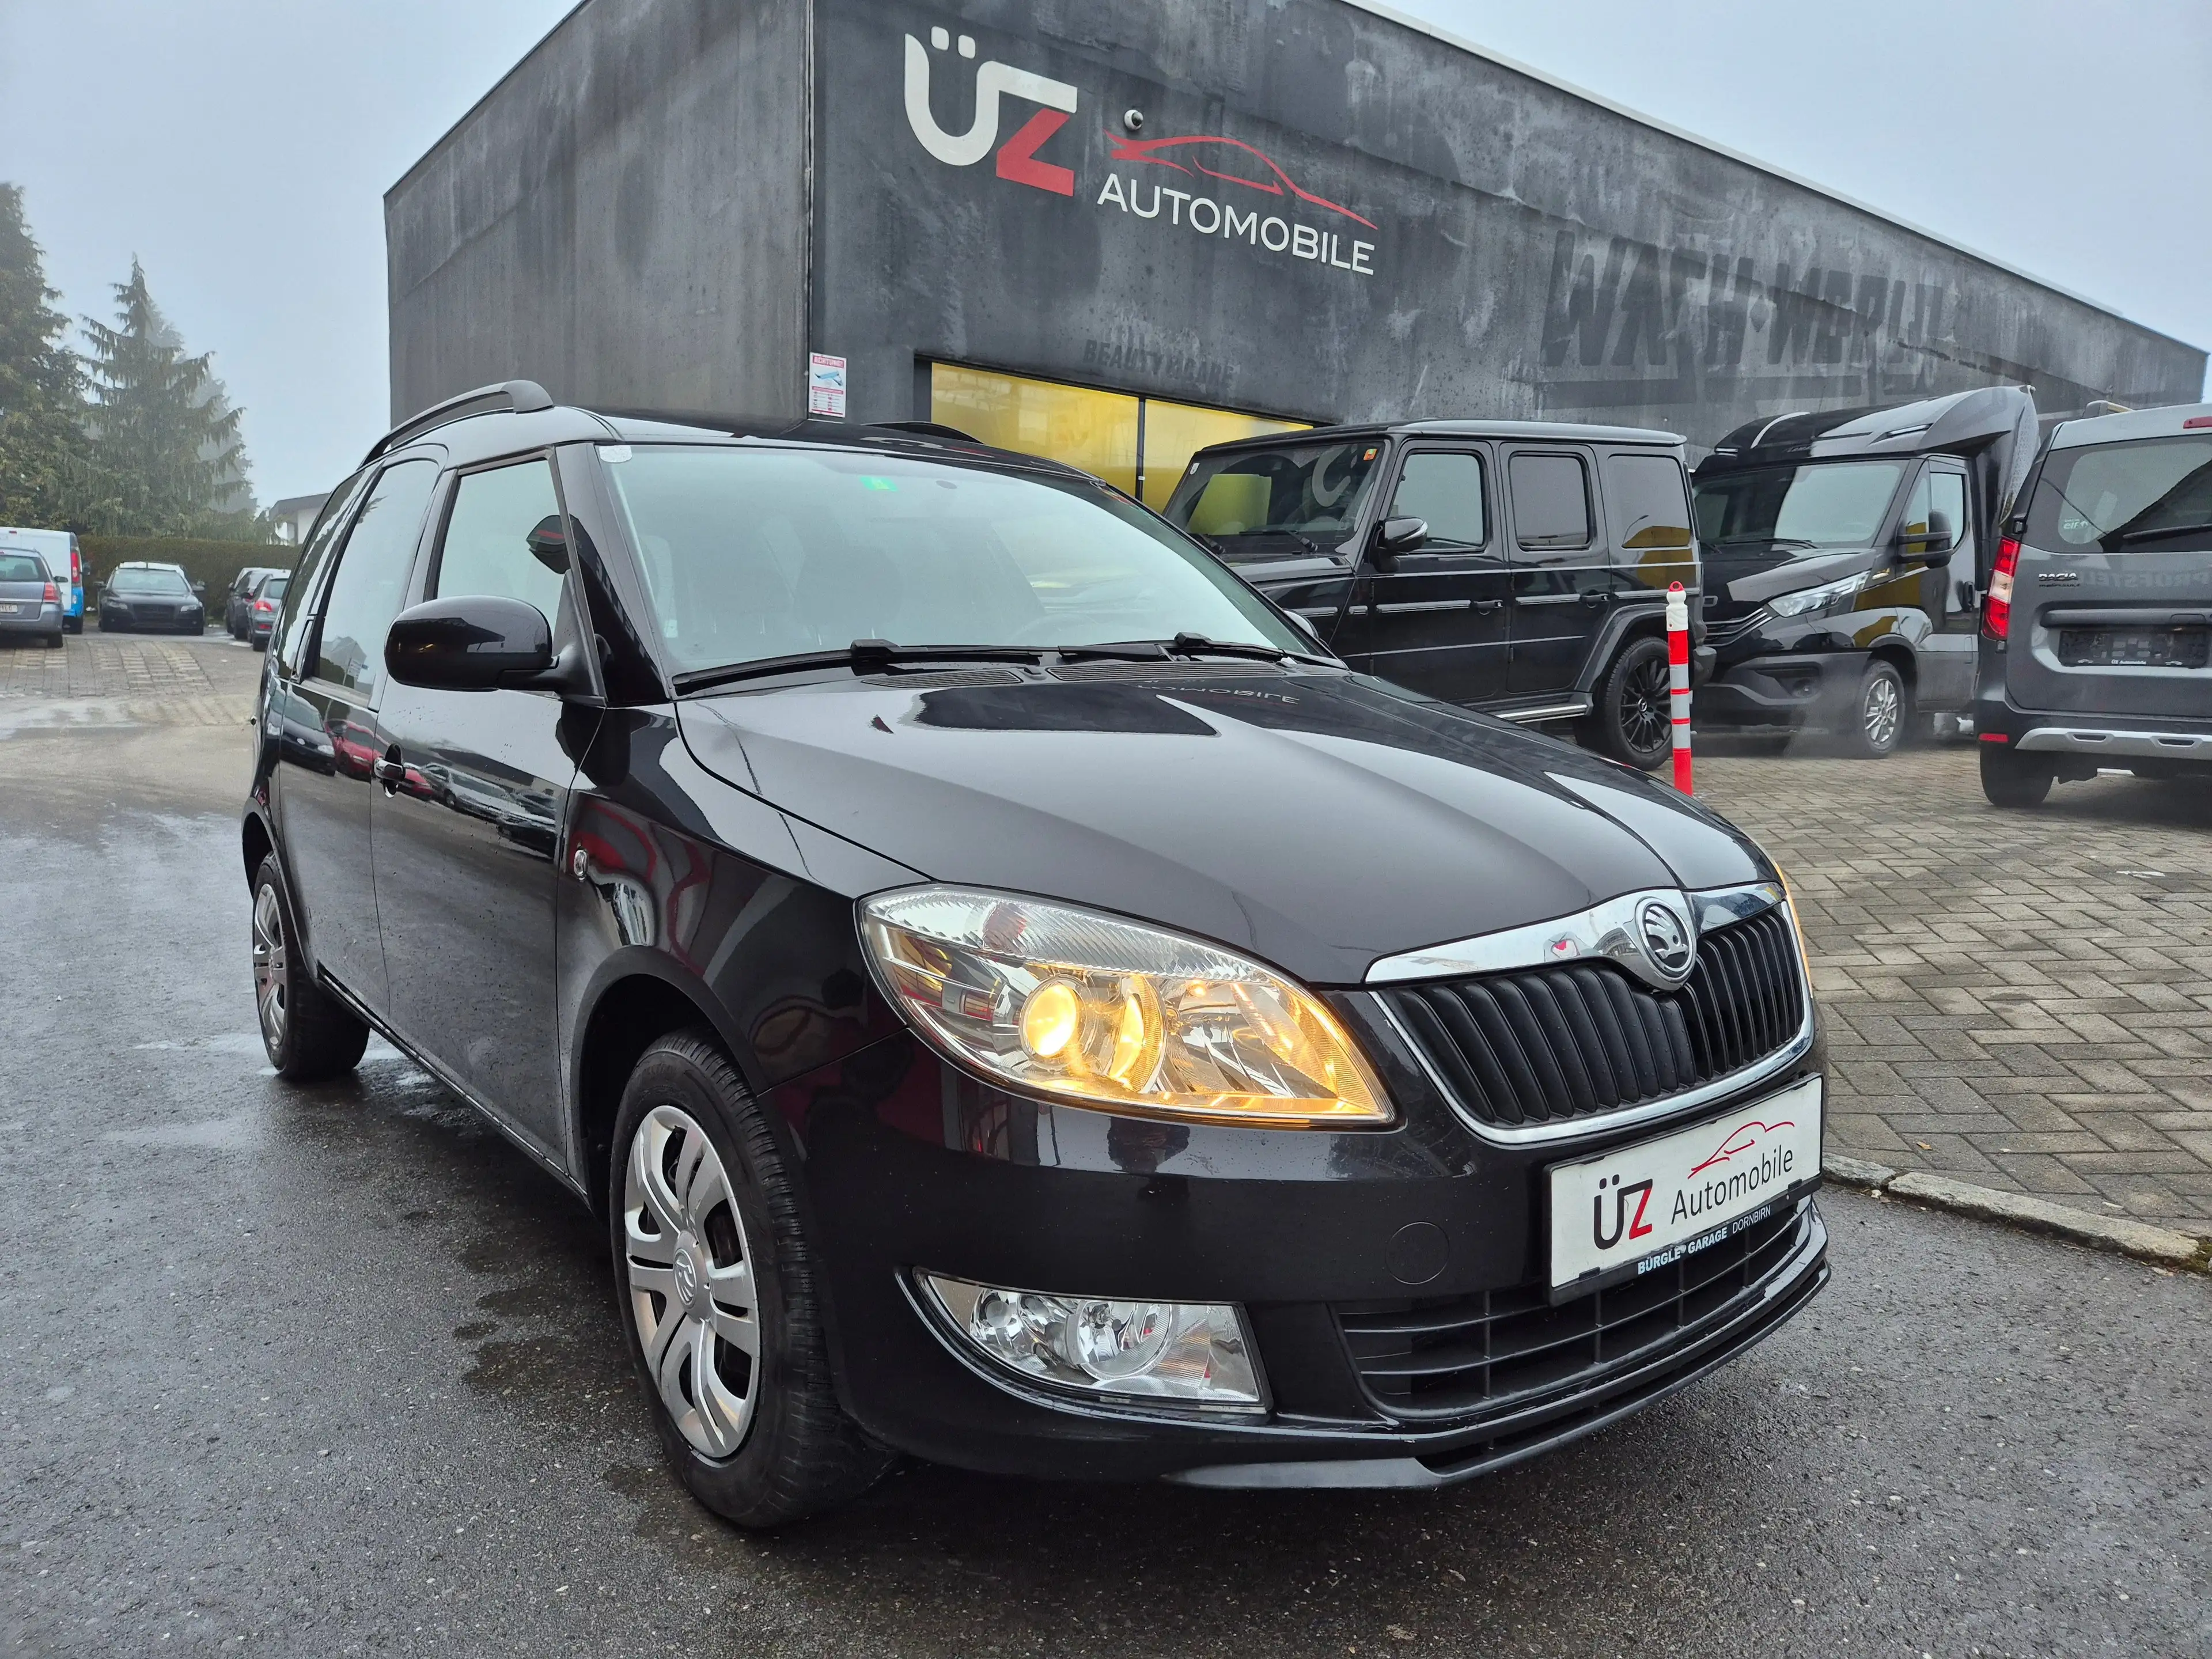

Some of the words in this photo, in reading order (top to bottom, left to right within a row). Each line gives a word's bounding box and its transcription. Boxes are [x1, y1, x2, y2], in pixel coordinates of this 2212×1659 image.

[904, 26, 1078, 196] ÜZ
[1097, 173, 1376, 275] AUTOMOBILE
[2038, 572, 2079, 582] DACIA
[1594, 1173, 1653, 1249] ÜZ
[1671, 1144, 1793, 1225] Automobile
[1637, 1246, 1681, 1275] BÜRGLE
[1688, 1226, 1728, 1255] GARAGE
[1732, 1205, 1772, 1234] DORNBIRN
